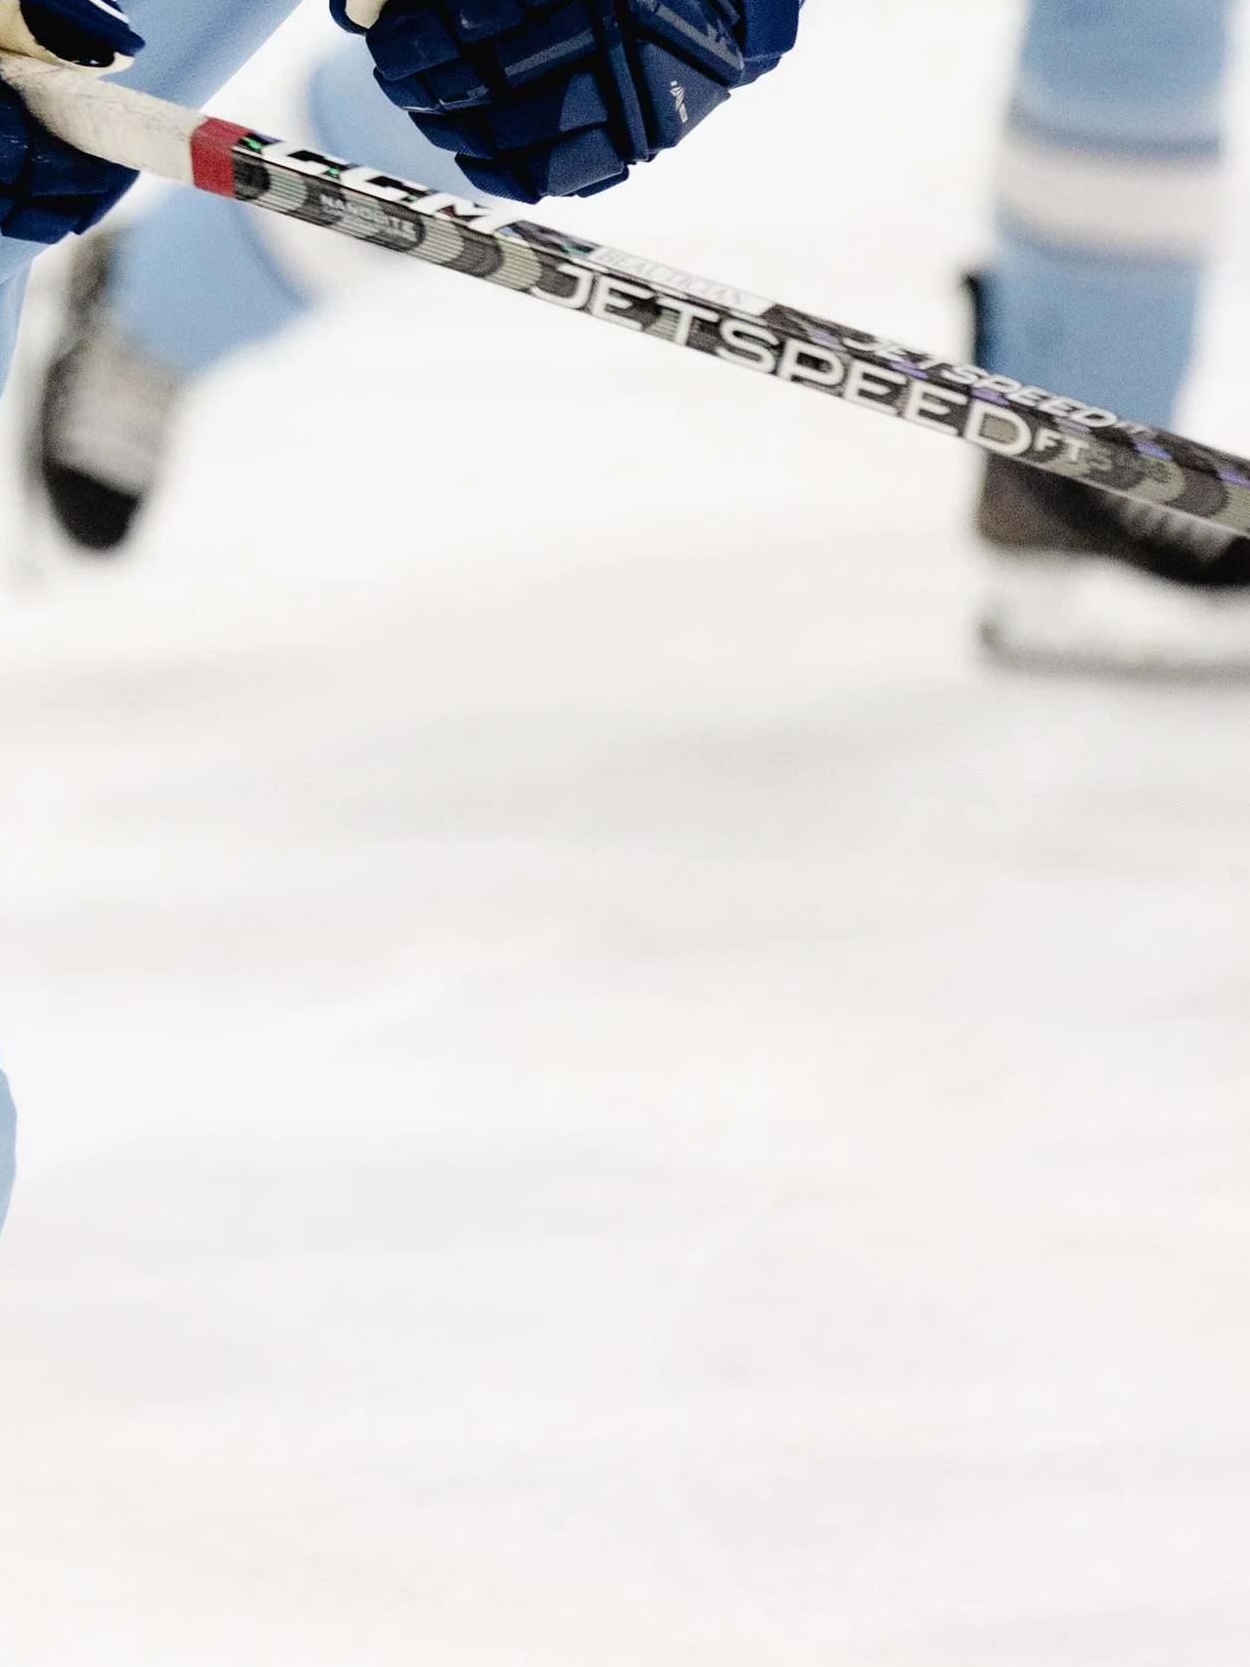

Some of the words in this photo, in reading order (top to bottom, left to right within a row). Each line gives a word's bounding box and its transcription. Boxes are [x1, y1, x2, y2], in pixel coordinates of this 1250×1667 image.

[261, 141, 528, 236] CCM
[530, 262, 1032, 456] JETSPEED
[841, 334, 1119, 428] JETSPEED
